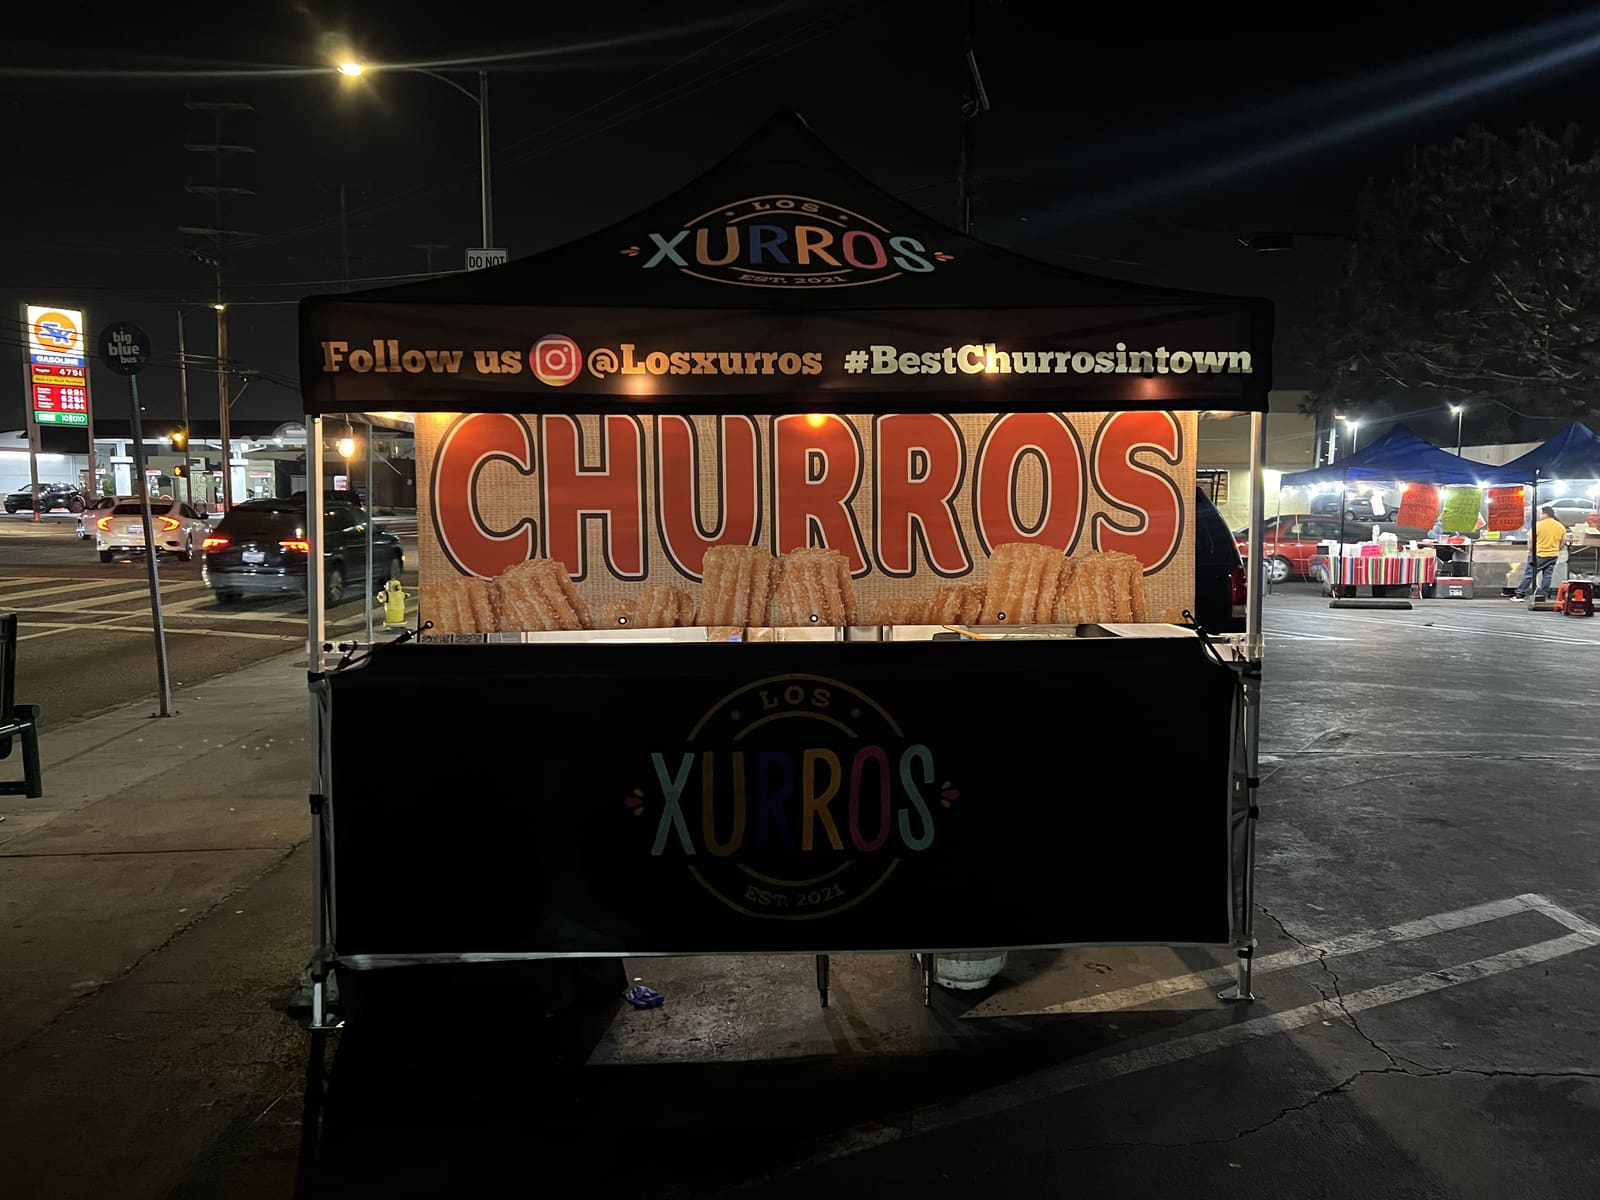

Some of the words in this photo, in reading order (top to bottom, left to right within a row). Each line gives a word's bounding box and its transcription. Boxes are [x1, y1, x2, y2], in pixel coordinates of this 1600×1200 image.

[751, 199, 820, 213] LOS
[642, 225, 936, 273] XURROS
[469, 256, 483, 268] DO
[486, 256, 505, 267] NOT
[738, 274, 788, 284] EST.
[793, 275, 848, 284] 2021
[112, 330, 133, 344] big
[107, 342, 140, 356] blue
[321, 339, 463, 374] Follow
[474, 350, 522, 374] us
[36, 355, 78, 365] GASOLINE
[120, 355, 138, 364] bus
[587, 343, 823, 379] @Losxurros
[843, 342, 1253, 375] #BestChurrosintown
[430, 412, 1185, 582] CHURROS
[758, 685, 832, 710] LOS
[650, 744, 936, 856] XURROS
[743, 883, 789, 907] EST.
[795, 883, 846, 906] 2021
